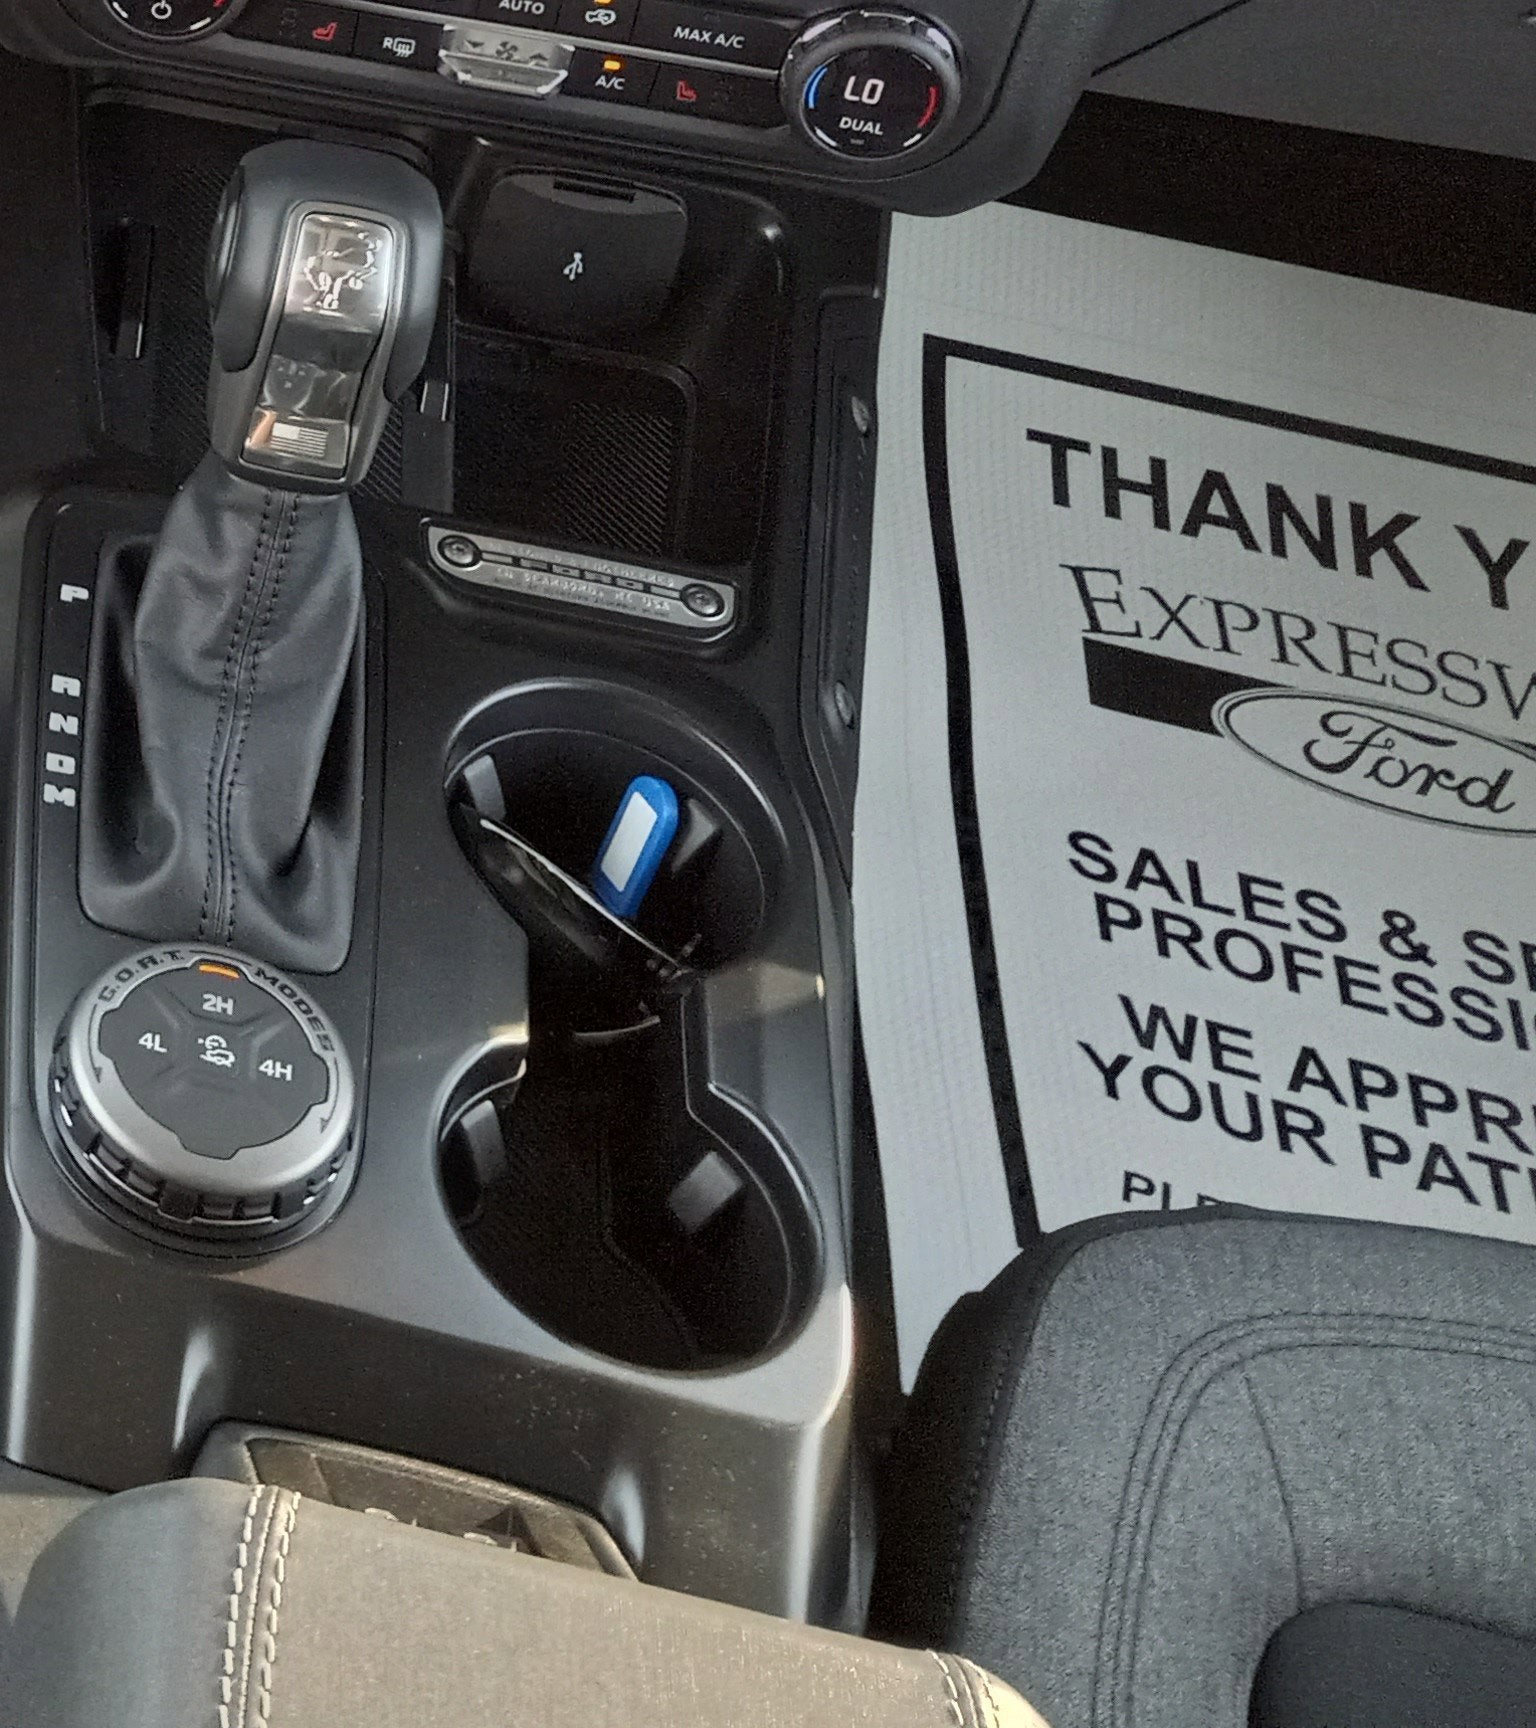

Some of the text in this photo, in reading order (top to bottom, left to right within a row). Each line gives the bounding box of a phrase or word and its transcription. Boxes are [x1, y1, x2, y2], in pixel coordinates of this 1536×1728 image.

[674, 25, 745, 50] MAX A/C
[595, 75, 626, 90] A/C
[843, 74, 884, 106] LO
[839, 117, 883, 137] DUAL
[1025, 427, 1431, 593] THANK
[60, 584, 90, 603] P
[51, 674, 81, 698] R
[48, 712, 79, 736] N
[45, 753, 77, 776] D
[1303, 709, 1516, 816] Ford
[43, 784, 76, 808] M
[1067, 831, 1348, 943] SALES
[1379, 909, 1438, 968] &
[1094, 890, 1536, 1051] PROFESSI
[202, 993, 235, 1015] 2H
[256, 967, 335, 1053] MODES
[138, 1033, 168, 1053] 4L
[259, 1059, 293, 1081] 4H
[1119, 994, 1536, 1156] WE APPR
[1077, 1040, 1336, 1164] YOUR
